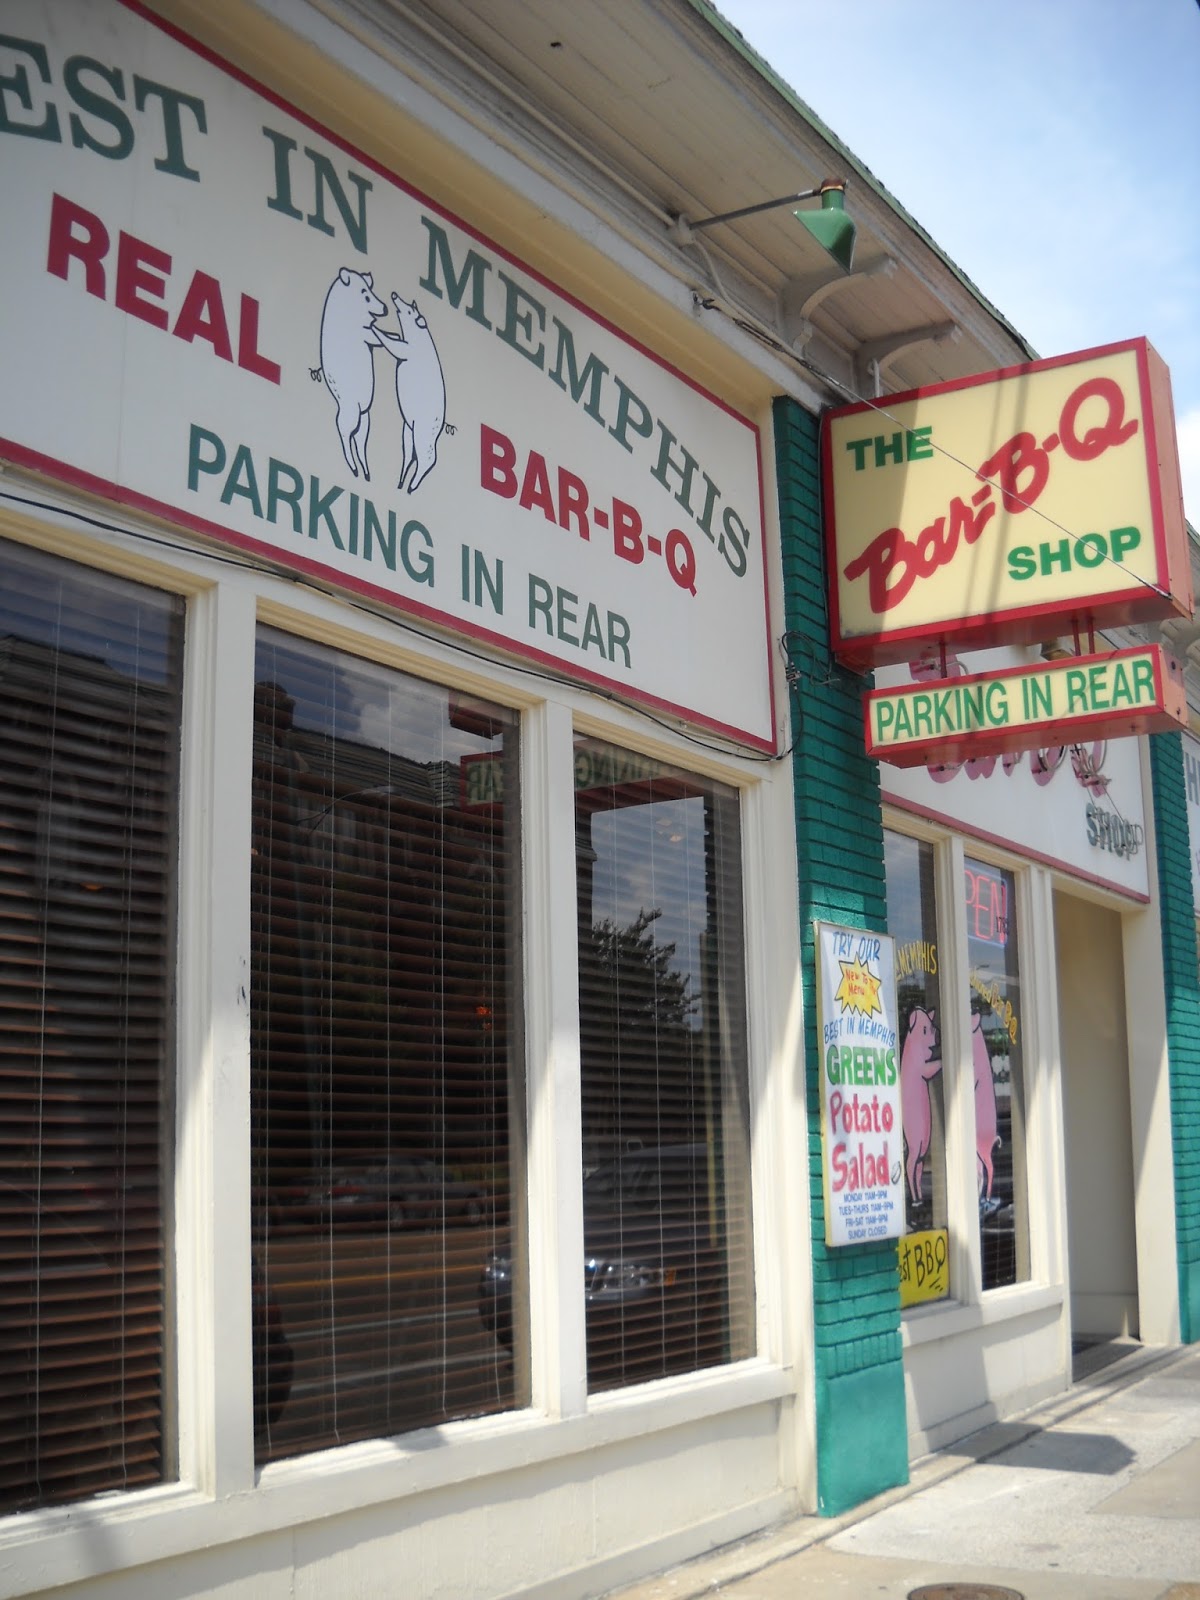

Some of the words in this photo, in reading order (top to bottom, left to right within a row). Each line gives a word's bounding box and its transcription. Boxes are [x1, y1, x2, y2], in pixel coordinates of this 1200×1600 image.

[47, 193, 281, 385] REAL
[262, 126, 373, 254] IN
[419, 215, 749, 578] MEMPHIS
[846, 426, 934, 471] THE
[480, 424, 697, 597] BAR-B-Q
[844, 377, 1138, 614] Bar-B-Q
[188, 424, 434, 588] PARKING
[461, 544, 503, 616] IN
[528, 573, 632, 669] REAR
[1007, 526, 1142, 580] SHOP
[876, 681, 1009, 743] PARKING
[1022, 675, 1052, 720] IN
[1066, 658, 1156, 713] REAR
[833, 932, 853, 957] TRY
[859, 937, 881, 961] OUR
[824, 1018, 844, 1044] BEST
[847, 1016, 856, 1034] IN
[858, 1018, 896, 1047] MEMPHIS
[827, 1045, 897, 1086] GREENS
[830, 1090, 893, 1134] Potato
[831, 1141, 890, 1192] Salad
[839, 1204, 869, 1216] TUES-THURS
[844, 1193, 863, 1203] MONDAY
[846, 1217, 863, 1227] FRI-SAT
[848, 1229, 866, 1240] SUNDAY
[868, 1225, 887, 1237] CLOSED
[914, 1235, 946, 1288] BBQ
